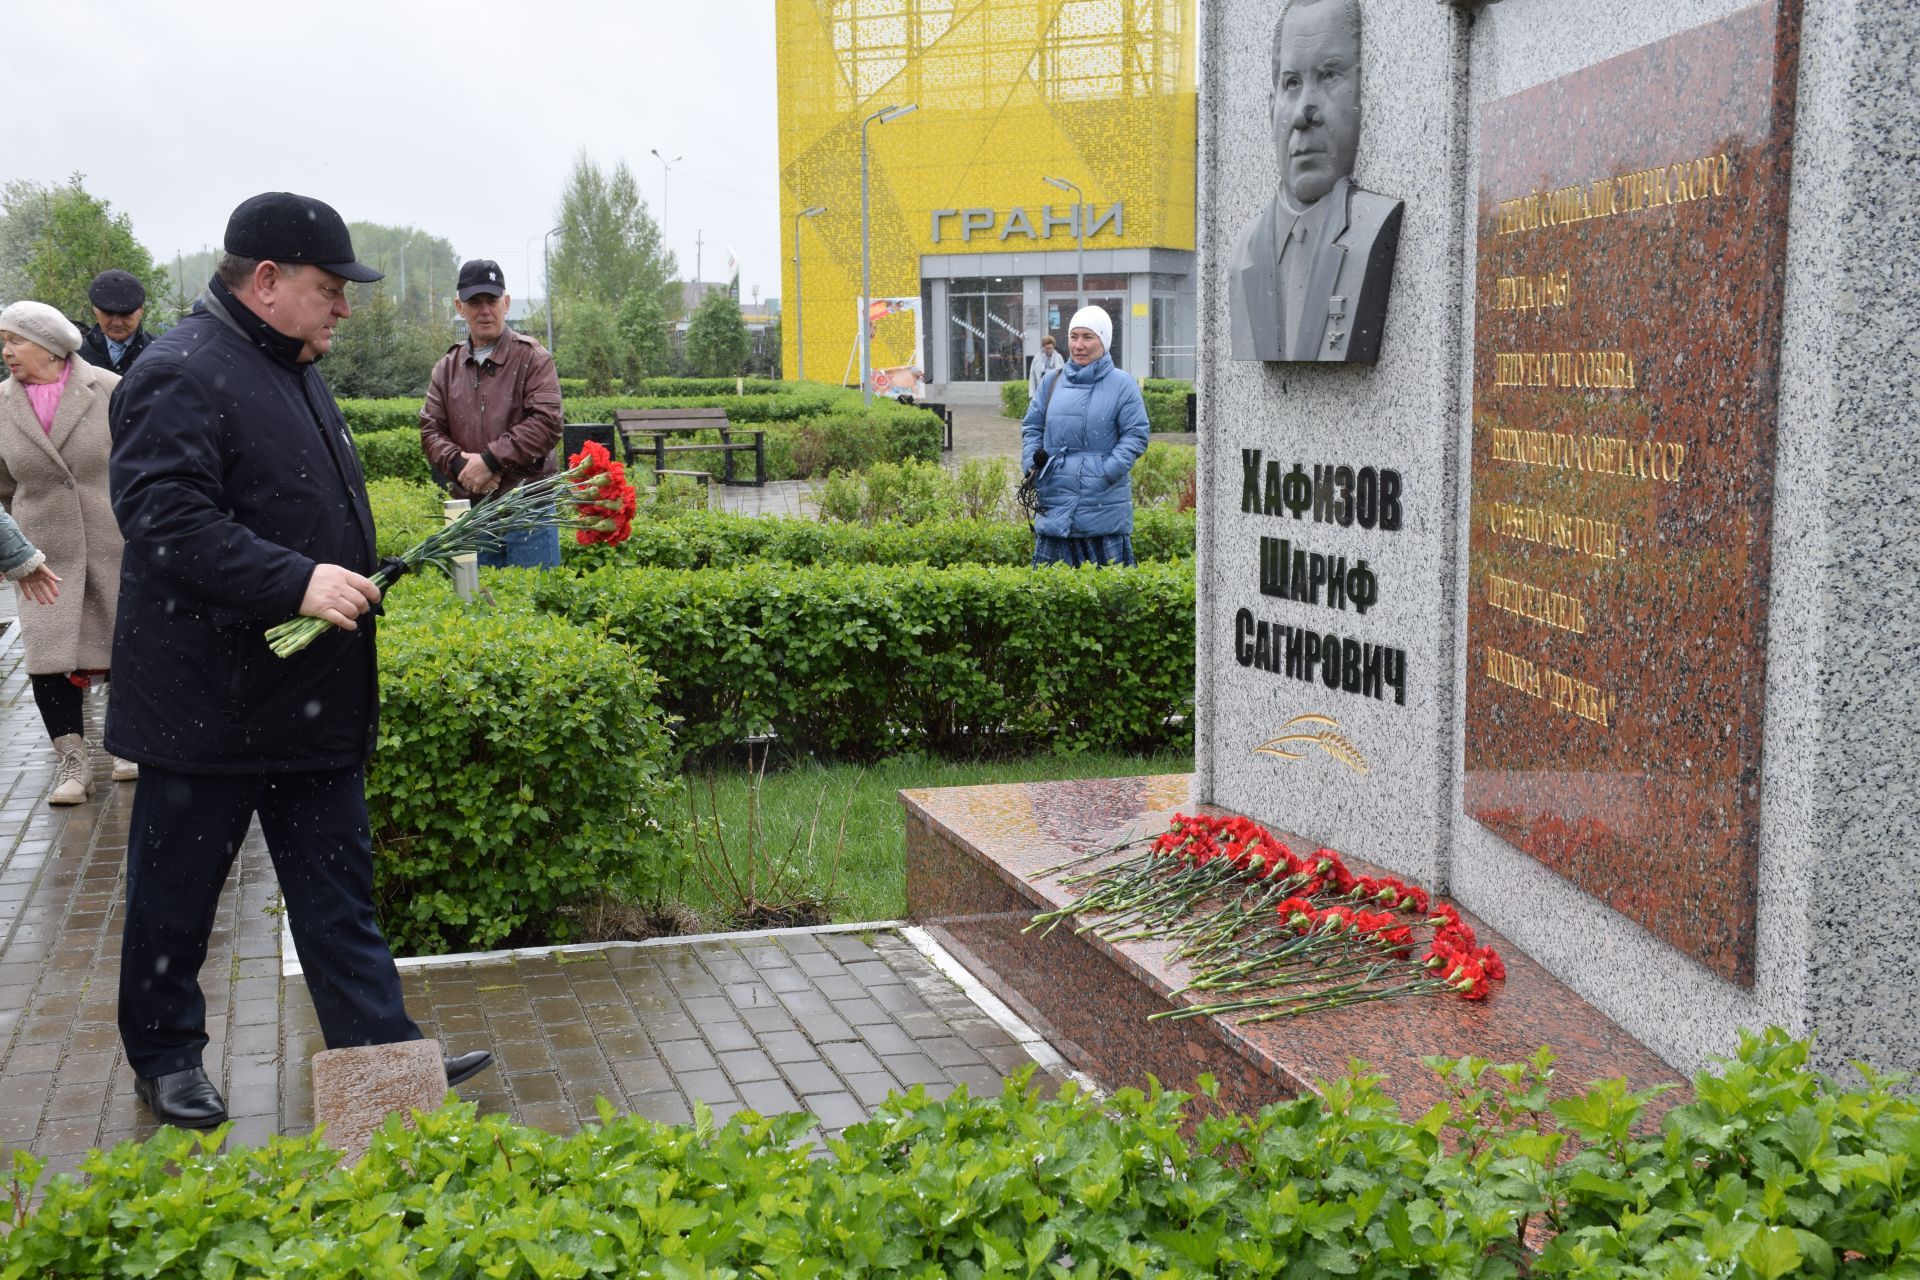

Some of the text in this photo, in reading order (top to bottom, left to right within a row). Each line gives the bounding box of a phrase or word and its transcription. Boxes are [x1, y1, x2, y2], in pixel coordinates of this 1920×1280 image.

[931, 202, 1124, 243] ГРАНИ
[1497, 153, 1729, 234] ГЕРОЙ СОЦИАЛИСТИЧЕСКОГО
[1496, 276, 1534, 316] ТРУДА
[1494, 352, 1636, 394] ДЕПУТАТ VII СОЗЫВА
[1492, 427, 1685, 482] ВЕРХОВНОГО СОВЕТА СССР
[1241, 448, 1404, 531] ХАФИЗОВ
[1490, 502, 1499, 534] С
[1525, 507, 1545, 543] ПО
[1574, 517, 1618, 566] ГОДЫ
[1259, 536, 1378, 615] ШАРИФ
[1487, 574, 1585, 634] ПРЕДСЕДАТЕЛЬ
[1234, 607, 1407, 706] САГИРОВИЧ
[1486, 645, 1616, 727] КОЛХОЗА "ДРУЖБА"
